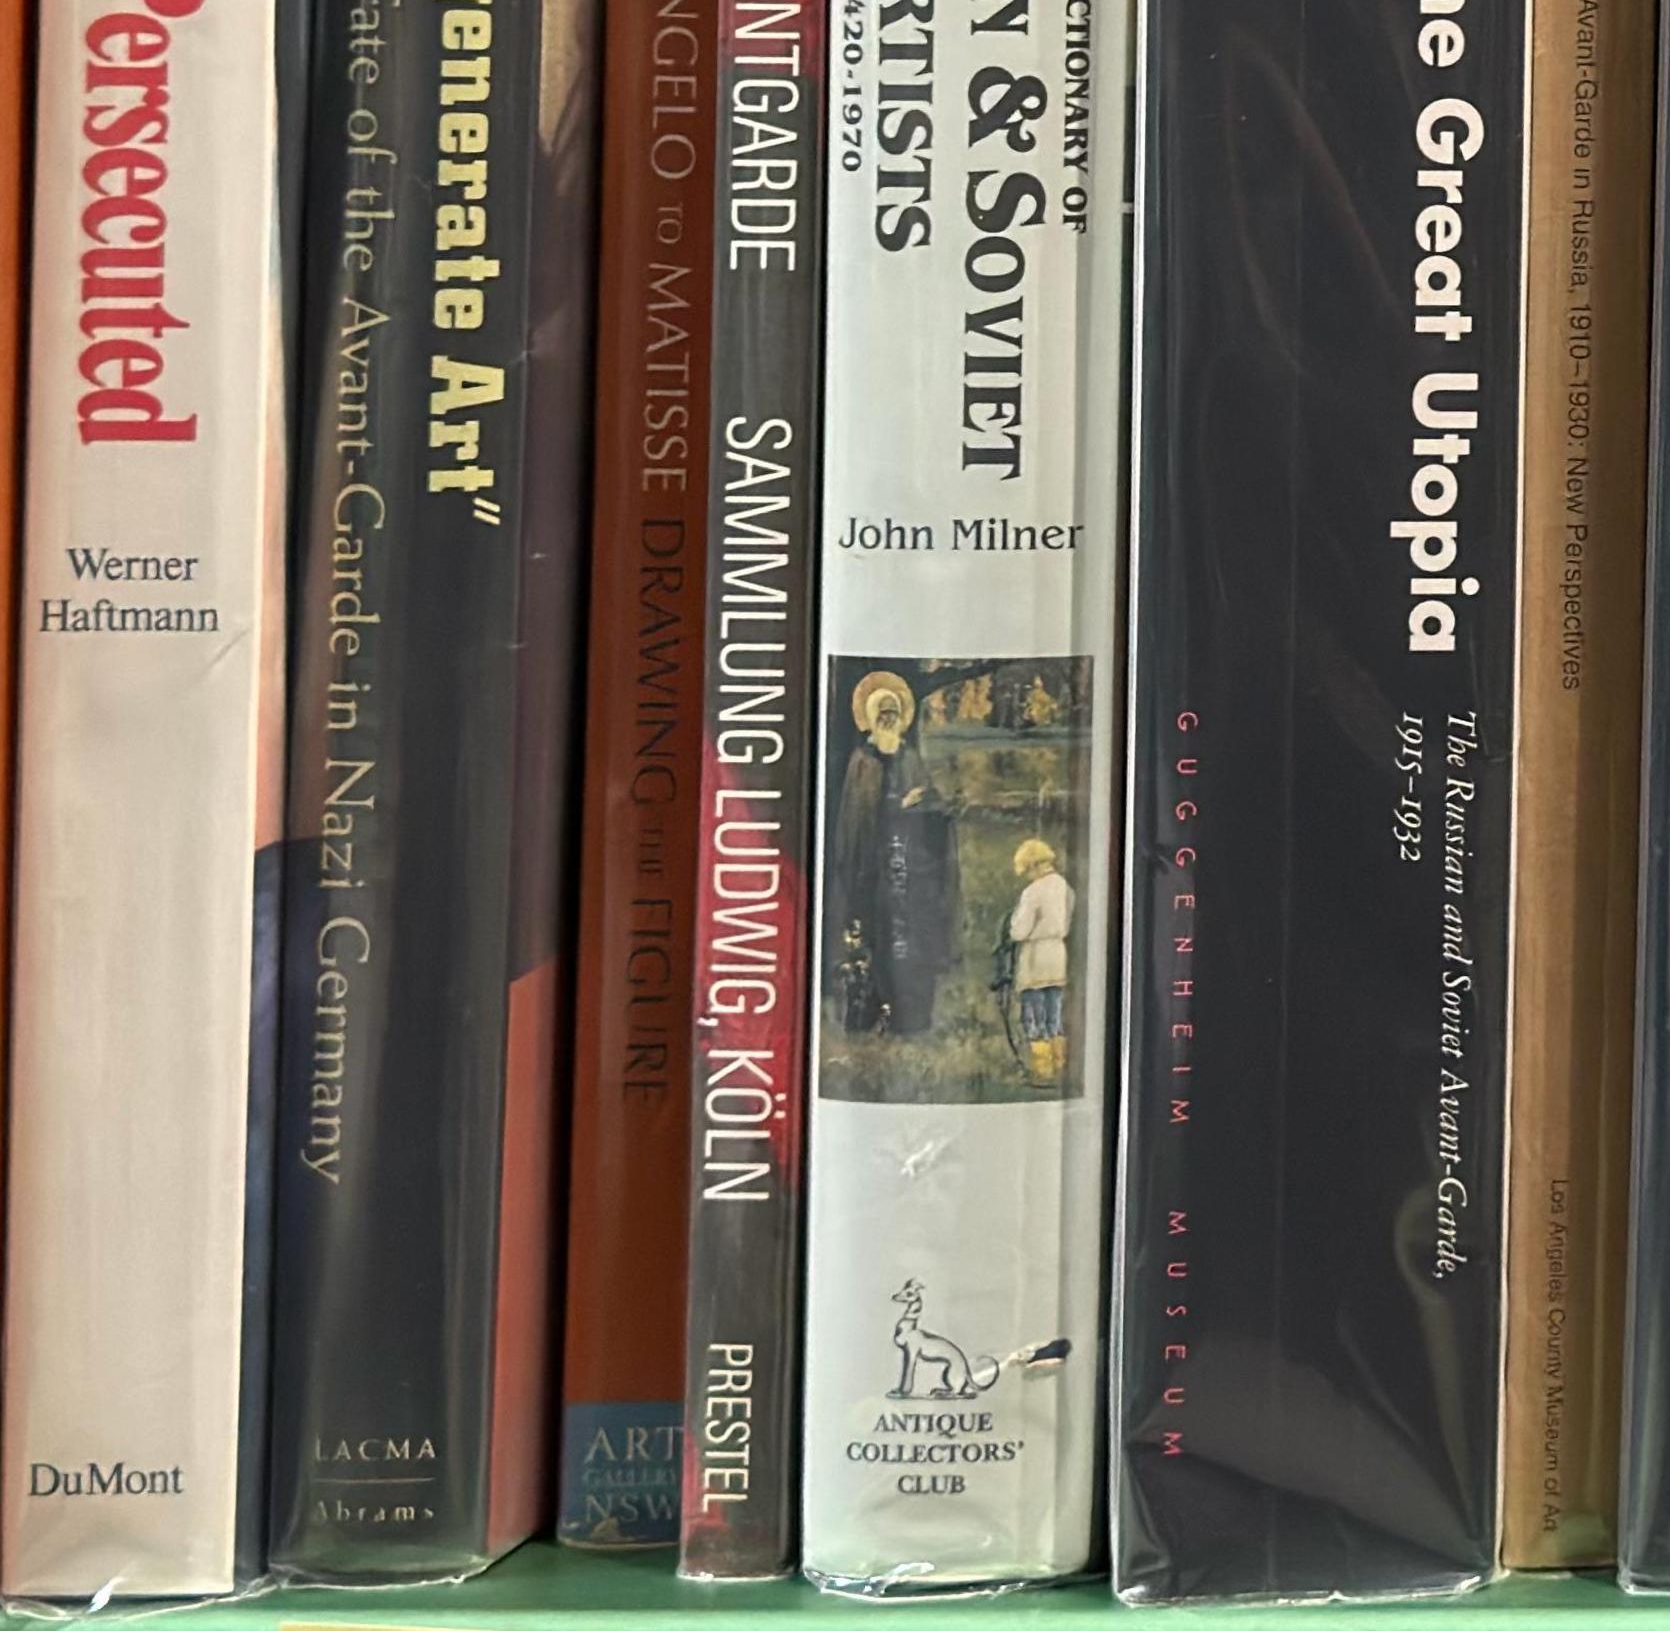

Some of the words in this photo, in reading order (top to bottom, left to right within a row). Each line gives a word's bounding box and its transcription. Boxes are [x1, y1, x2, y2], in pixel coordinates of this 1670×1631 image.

[346, 103, 400, 166] of
[966, 65, 1048, 150] &
[342, 164, 394, 272] the
[1062, 189, 1087, 233] OF
[1414, 97, 1485, 342] Great
[1574, 169, 1592, 191] in
[1569, 199, 1594, 290] Russia,
[960, 169, 1048, 478] SOVIET
[328, 295, 392, 653] Avant-Garde
[427, 354, 505, 525] Art"
[1566, 457, 1588, 504] New
[839, 516, 935, 552] John
[950, 516, 1084, 552] Milner
[1389, 373, 1479, 653] Utopia
[66, 547, 197, 583] Werner
[716, 414, 791, 766] SAMMLUNG
[1560, 514, 1589, 692] Perspectives
[39, 599, 219, 634] Haftmann
[325, 678, 374, 732] in
[1446, 710, 1479, 768] The
[322, 754, 377, 886] Nazi
[1444, 776, 1477, 895] Russian
[697, 789, 783, 1027] LUDWIG,
[1168, 710, 1200, 1127] GUGGENHEIM
[1442, 902, 1474, 966] and
[299, 917, 371, 1186] Germany
[1441, 970, 1474, 1059] Soviet
[702, 1048, 785, 1203] KÖLN
[1434, 1069, 1472, 1282] Avant-Garde,
[1163, 1209, 1190, 1459] MUSEUM
[702, 1343, 754, 1513] PRESTEL
[846, 1440, 1025, 1466] COLLECTORS'
[875, 1411, 993, 1437] ANTIQUE
[30, 1460, 184, 1496] DuMont
[898, 1473, 967, 1495] CLUB
